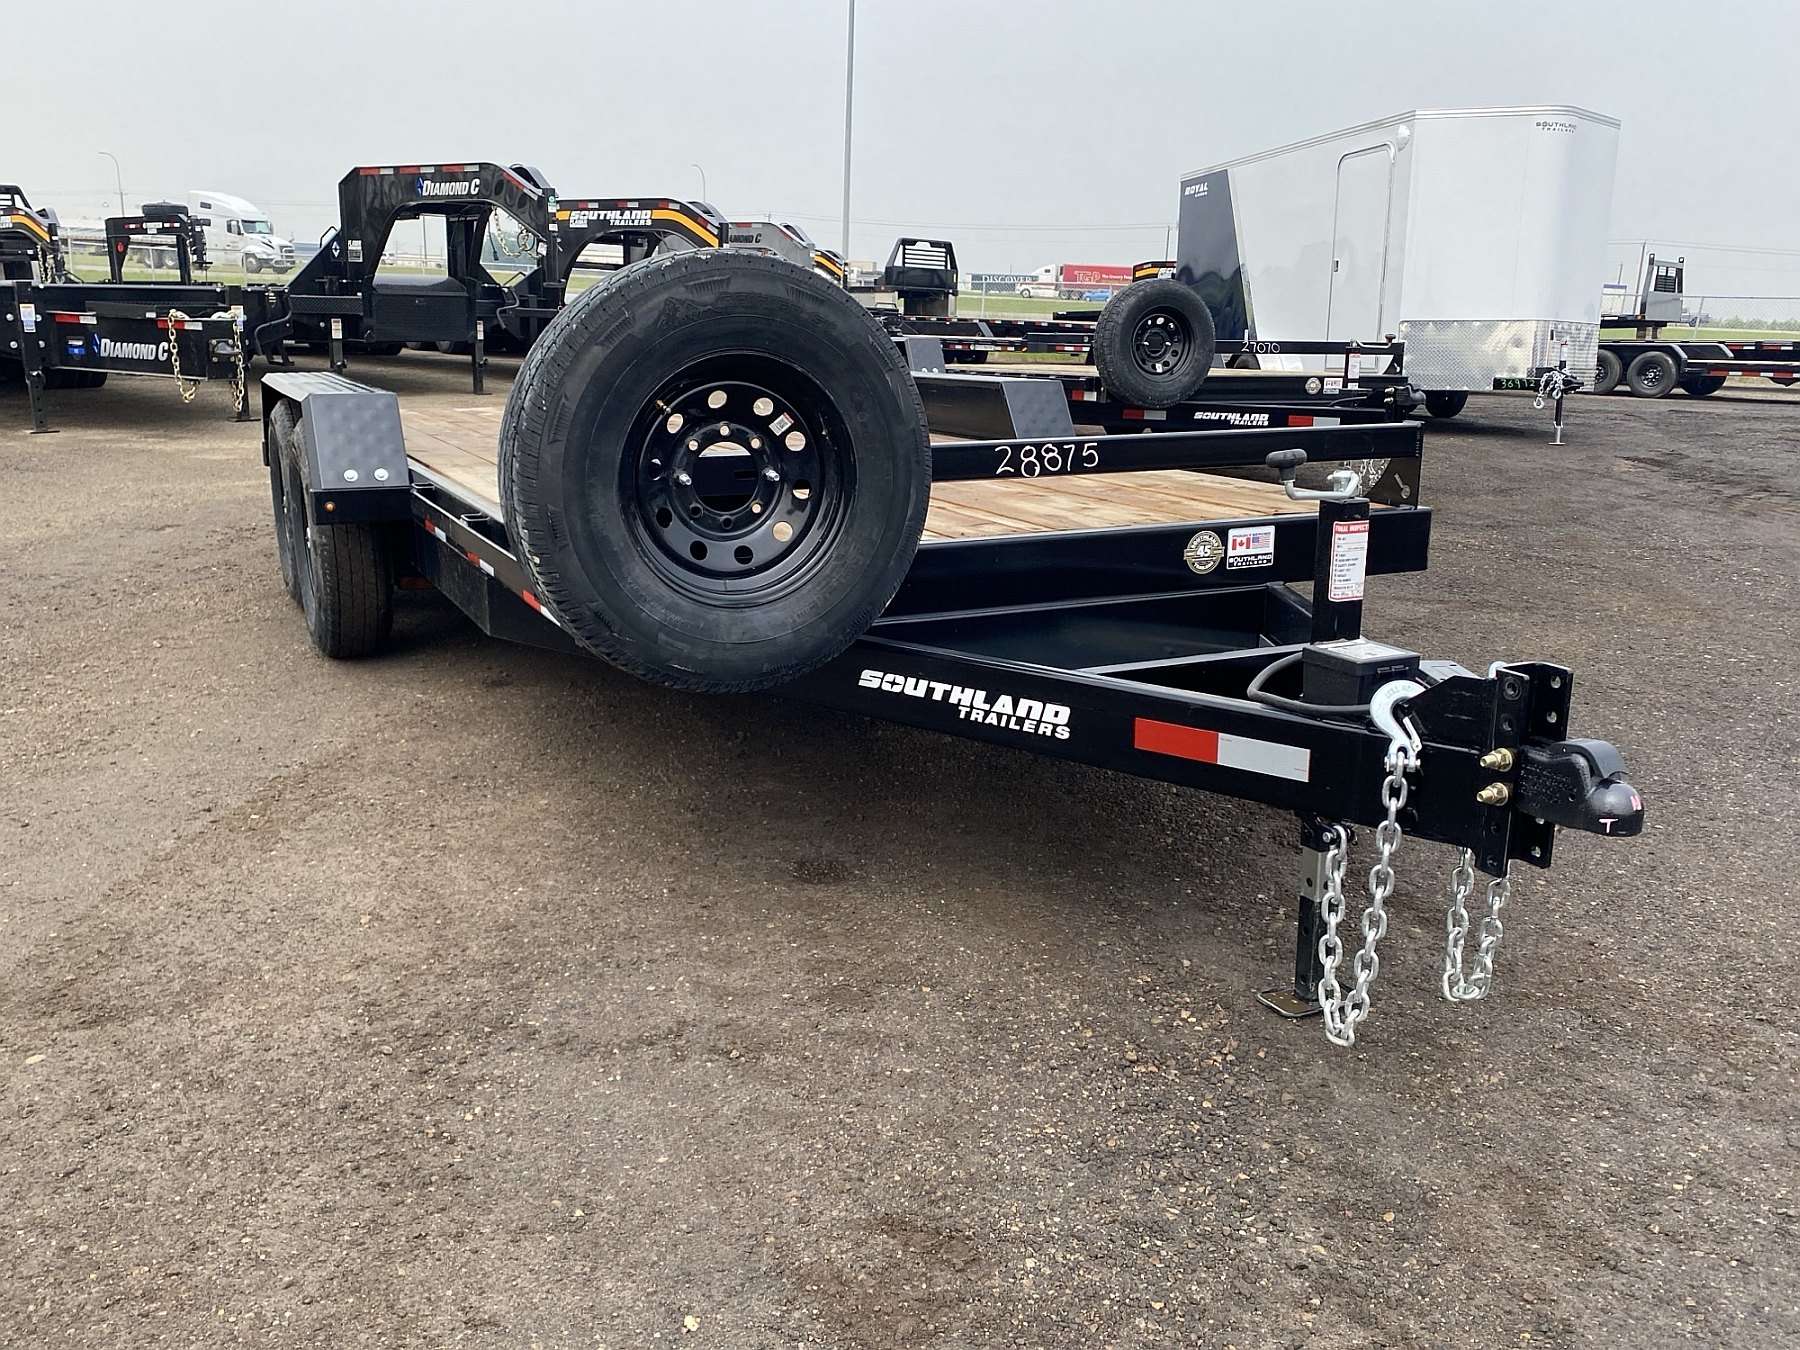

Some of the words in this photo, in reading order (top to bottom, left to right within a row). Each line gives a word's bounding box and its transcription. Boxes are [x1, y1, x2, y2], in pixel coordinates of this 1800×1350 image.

[422, 180, 470, 196] DIAMOND
[470, 178, 480, 195] C
[1184, 182, 1208, 196] ROYAL
[570, 210, 652, 220] SOUTHLAND
[754, 232, 762, 243] C
[100, 338, 157, 360] DIAMOND
[157, 341, 169, 361] C
[1241, 341, 1281, 354] 27070
[1193, 411, 1270, 421] SOUTHLAND
[994, 442, 1099, 478] 28875
[1197, 545, 1211, 558] 45
[1228, 554, 1273, 564] SOUTHLAND
[858, 669, 1071, 726] SOUTHLAND
[958, 705, 1071, 740] TRAILERS
